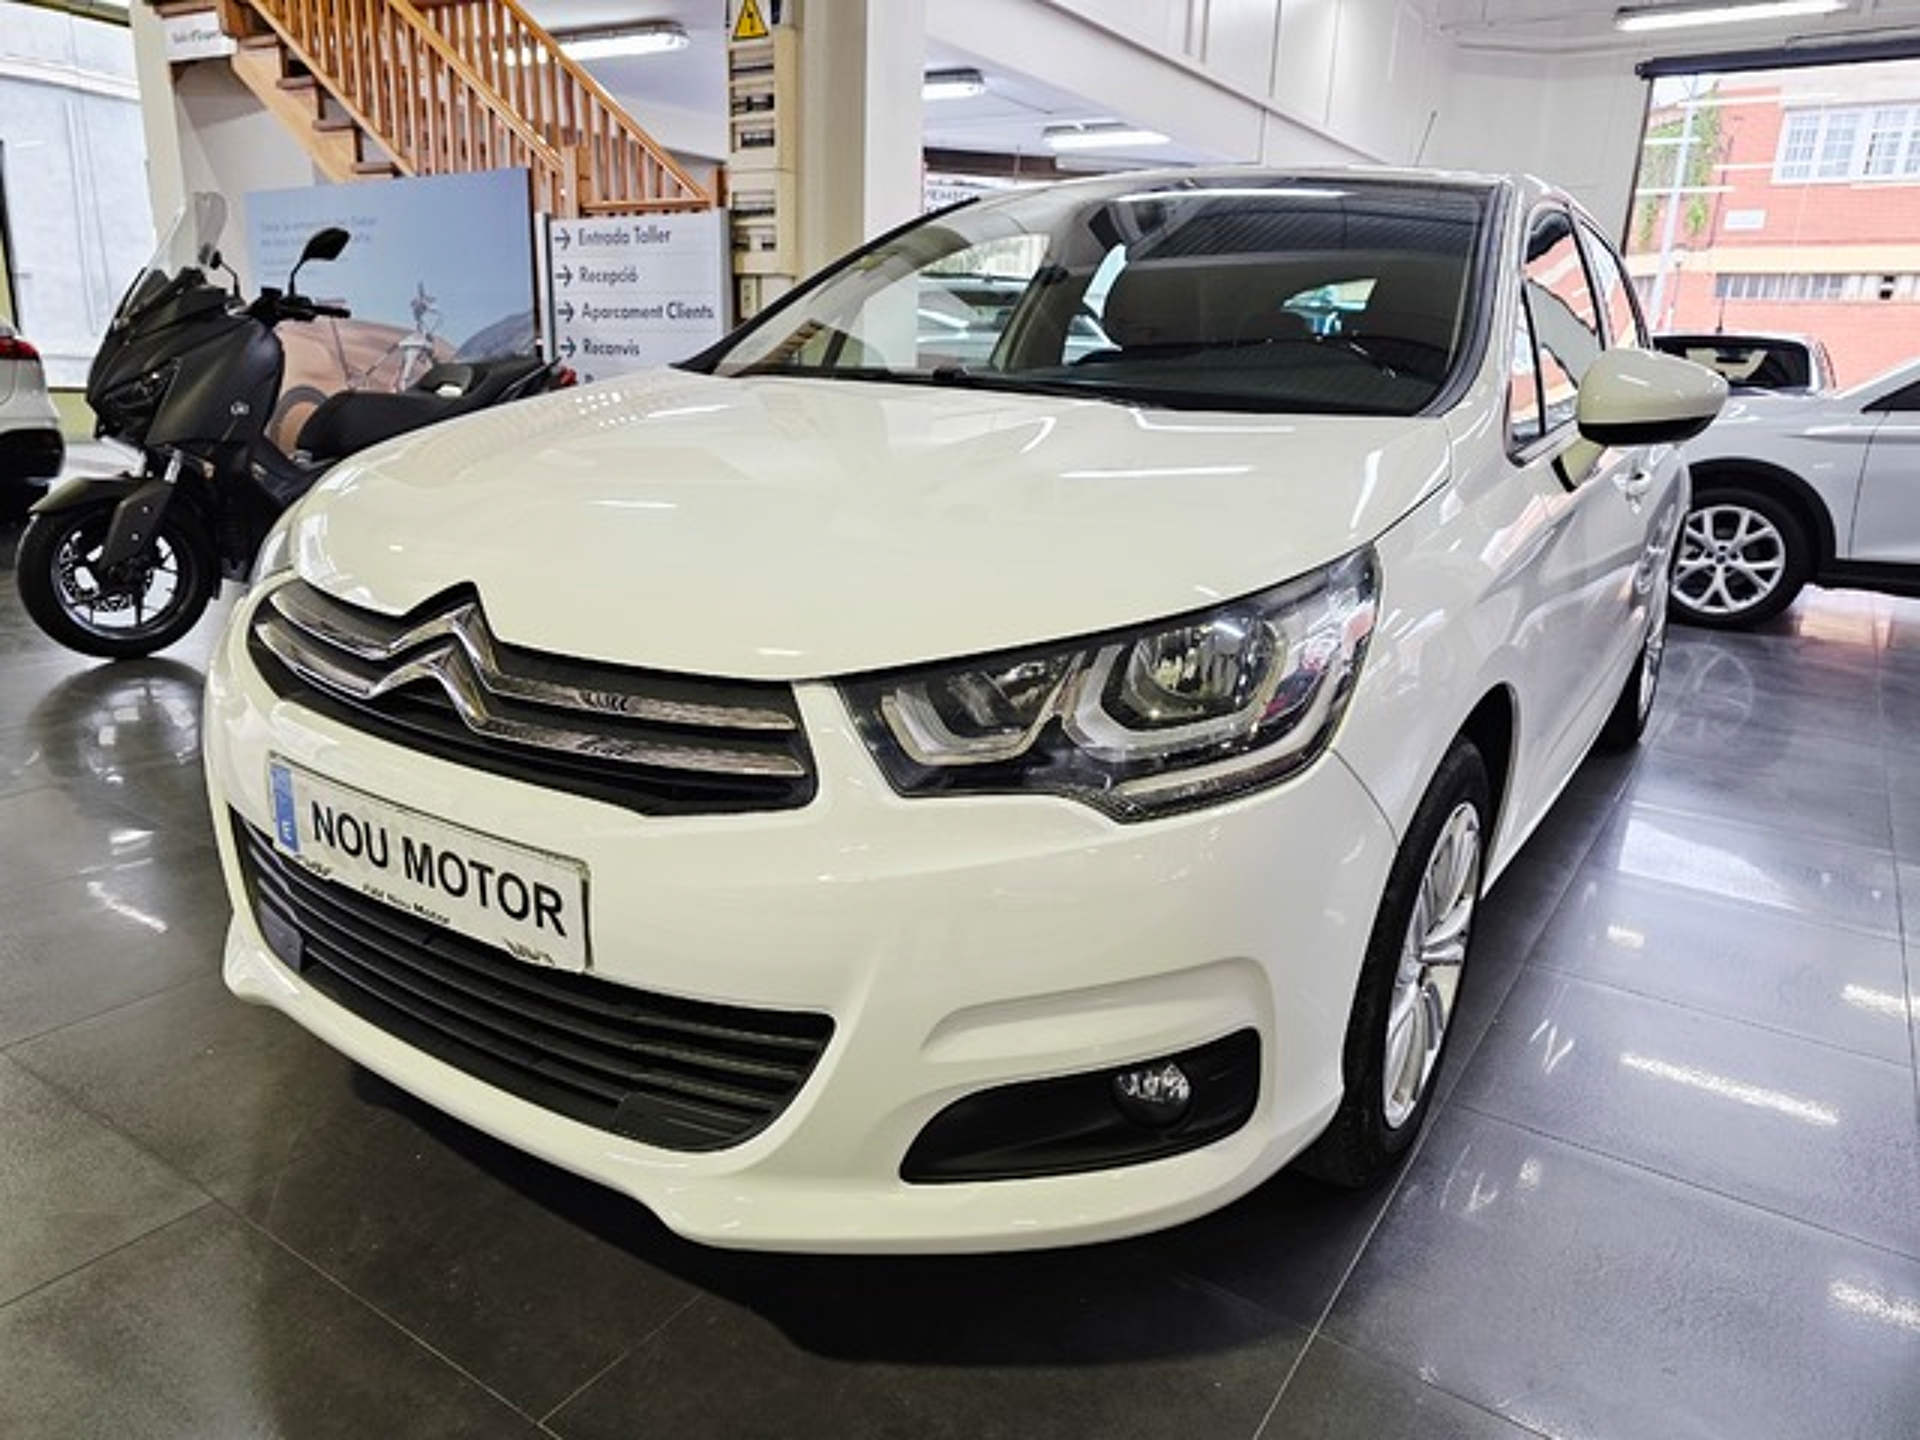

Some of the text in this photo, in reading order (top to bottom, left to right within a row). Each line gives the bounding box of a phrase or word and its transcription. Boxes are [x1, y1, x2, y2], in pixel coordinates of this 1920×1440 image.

[578, 225, 671, 246] Entrada Taller
[579, 266, 639, 285] Recepció
[582, 302, 714, 321] Aparcament Clients
[583, 337, 640, 355] Recanvis
[311, 800, 567, 937] NOU MOTOR
